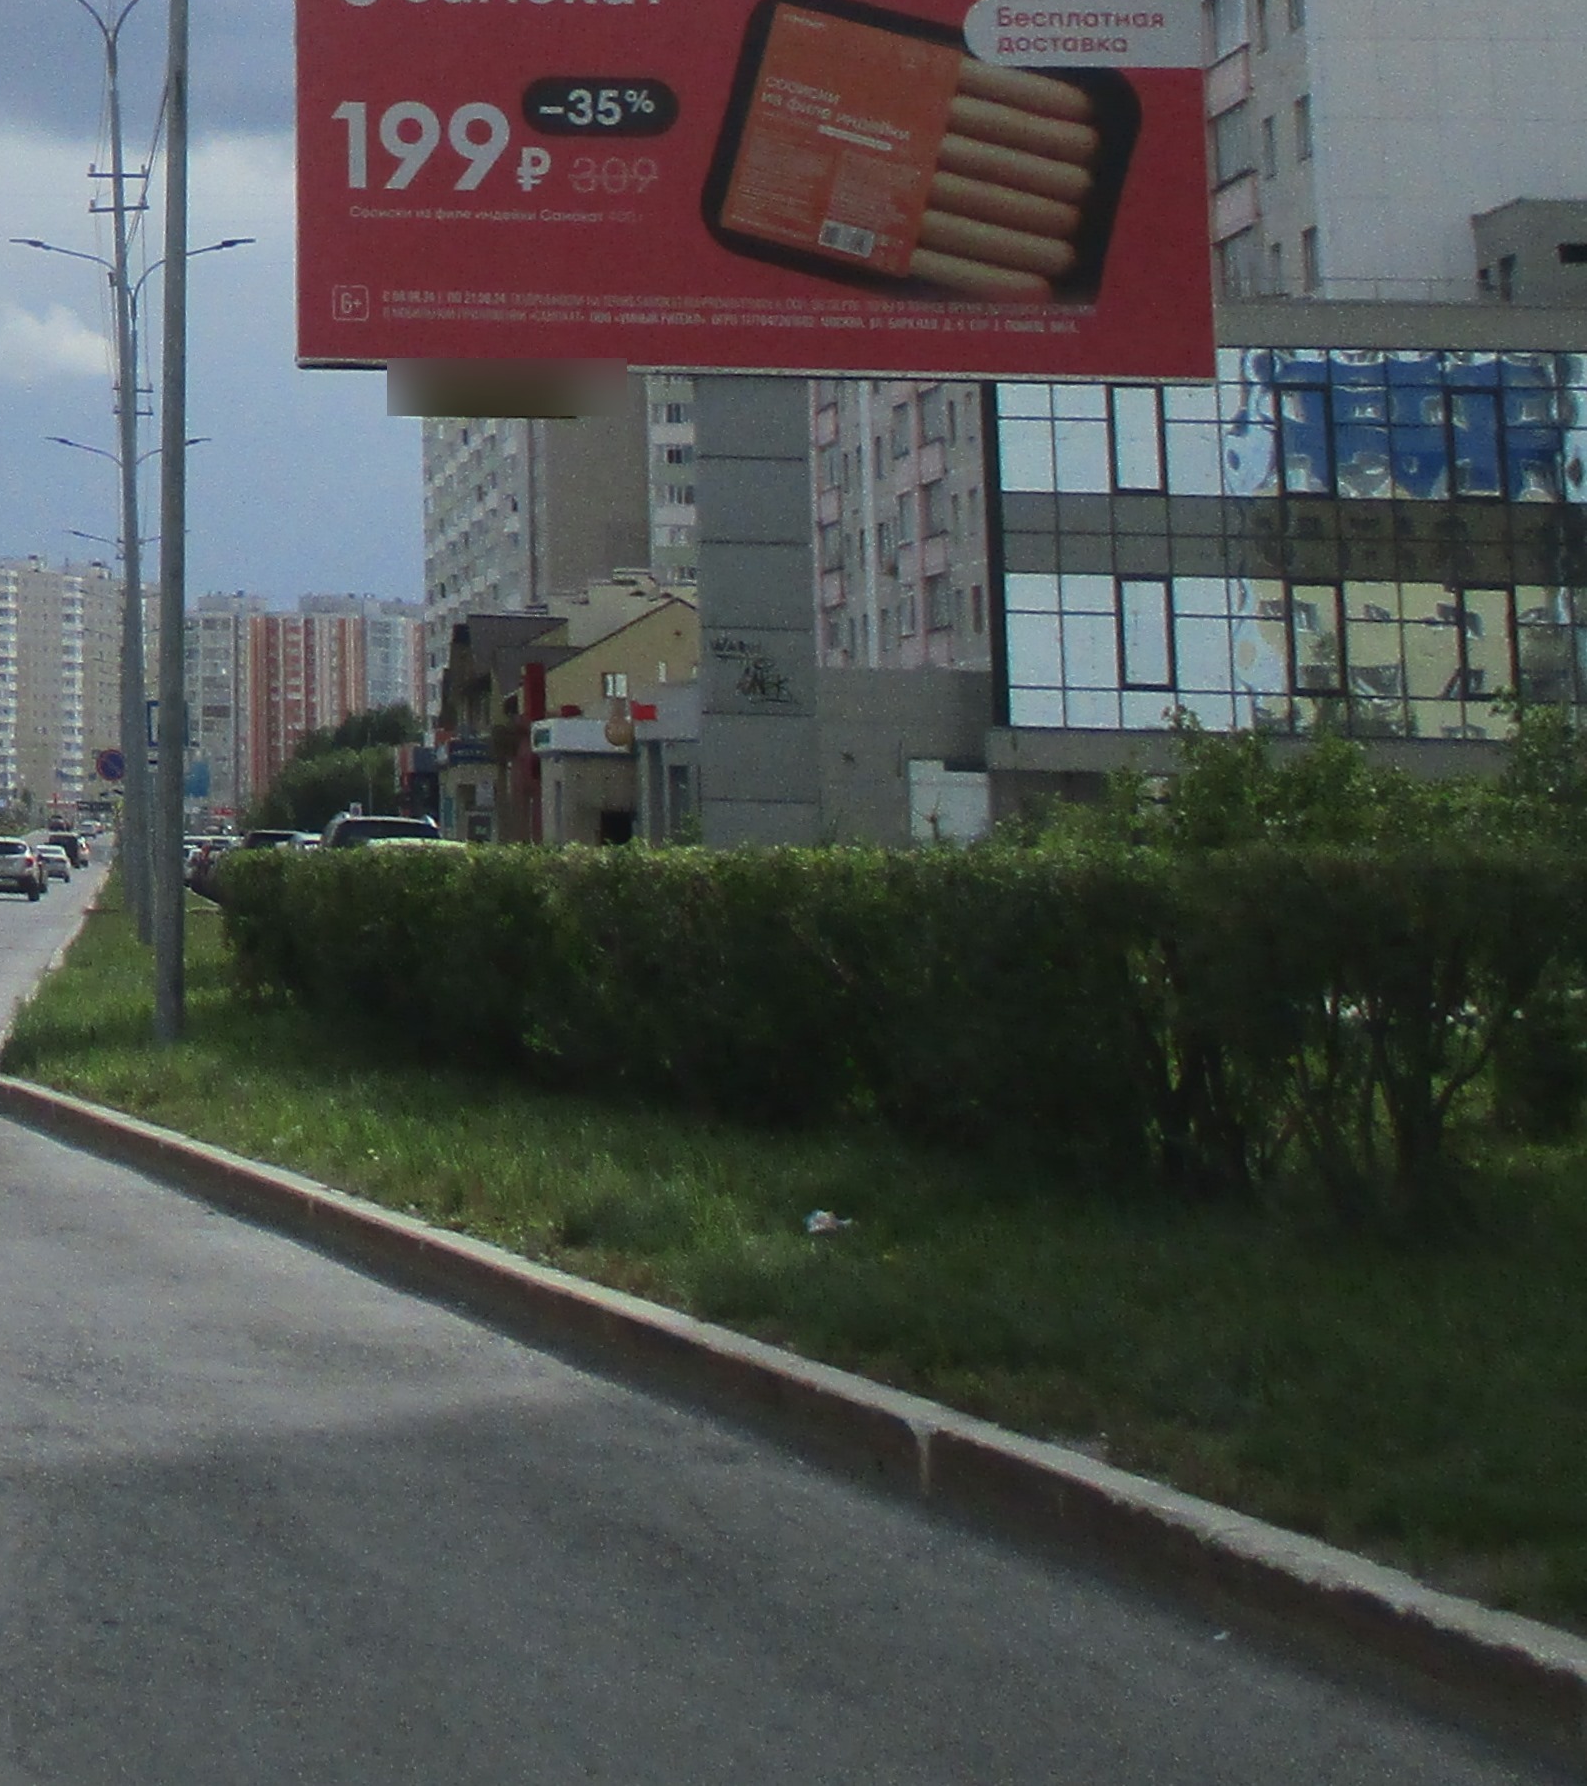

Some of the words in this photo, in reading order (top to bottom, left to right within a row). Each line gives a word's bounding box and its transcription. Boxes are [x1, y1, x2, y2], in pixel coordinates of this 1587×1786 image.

[996, 6, 1165, 28] Бесплатная
[997, 37, 1129, 54] доставка
[340, 292, 363, 314] 6+
